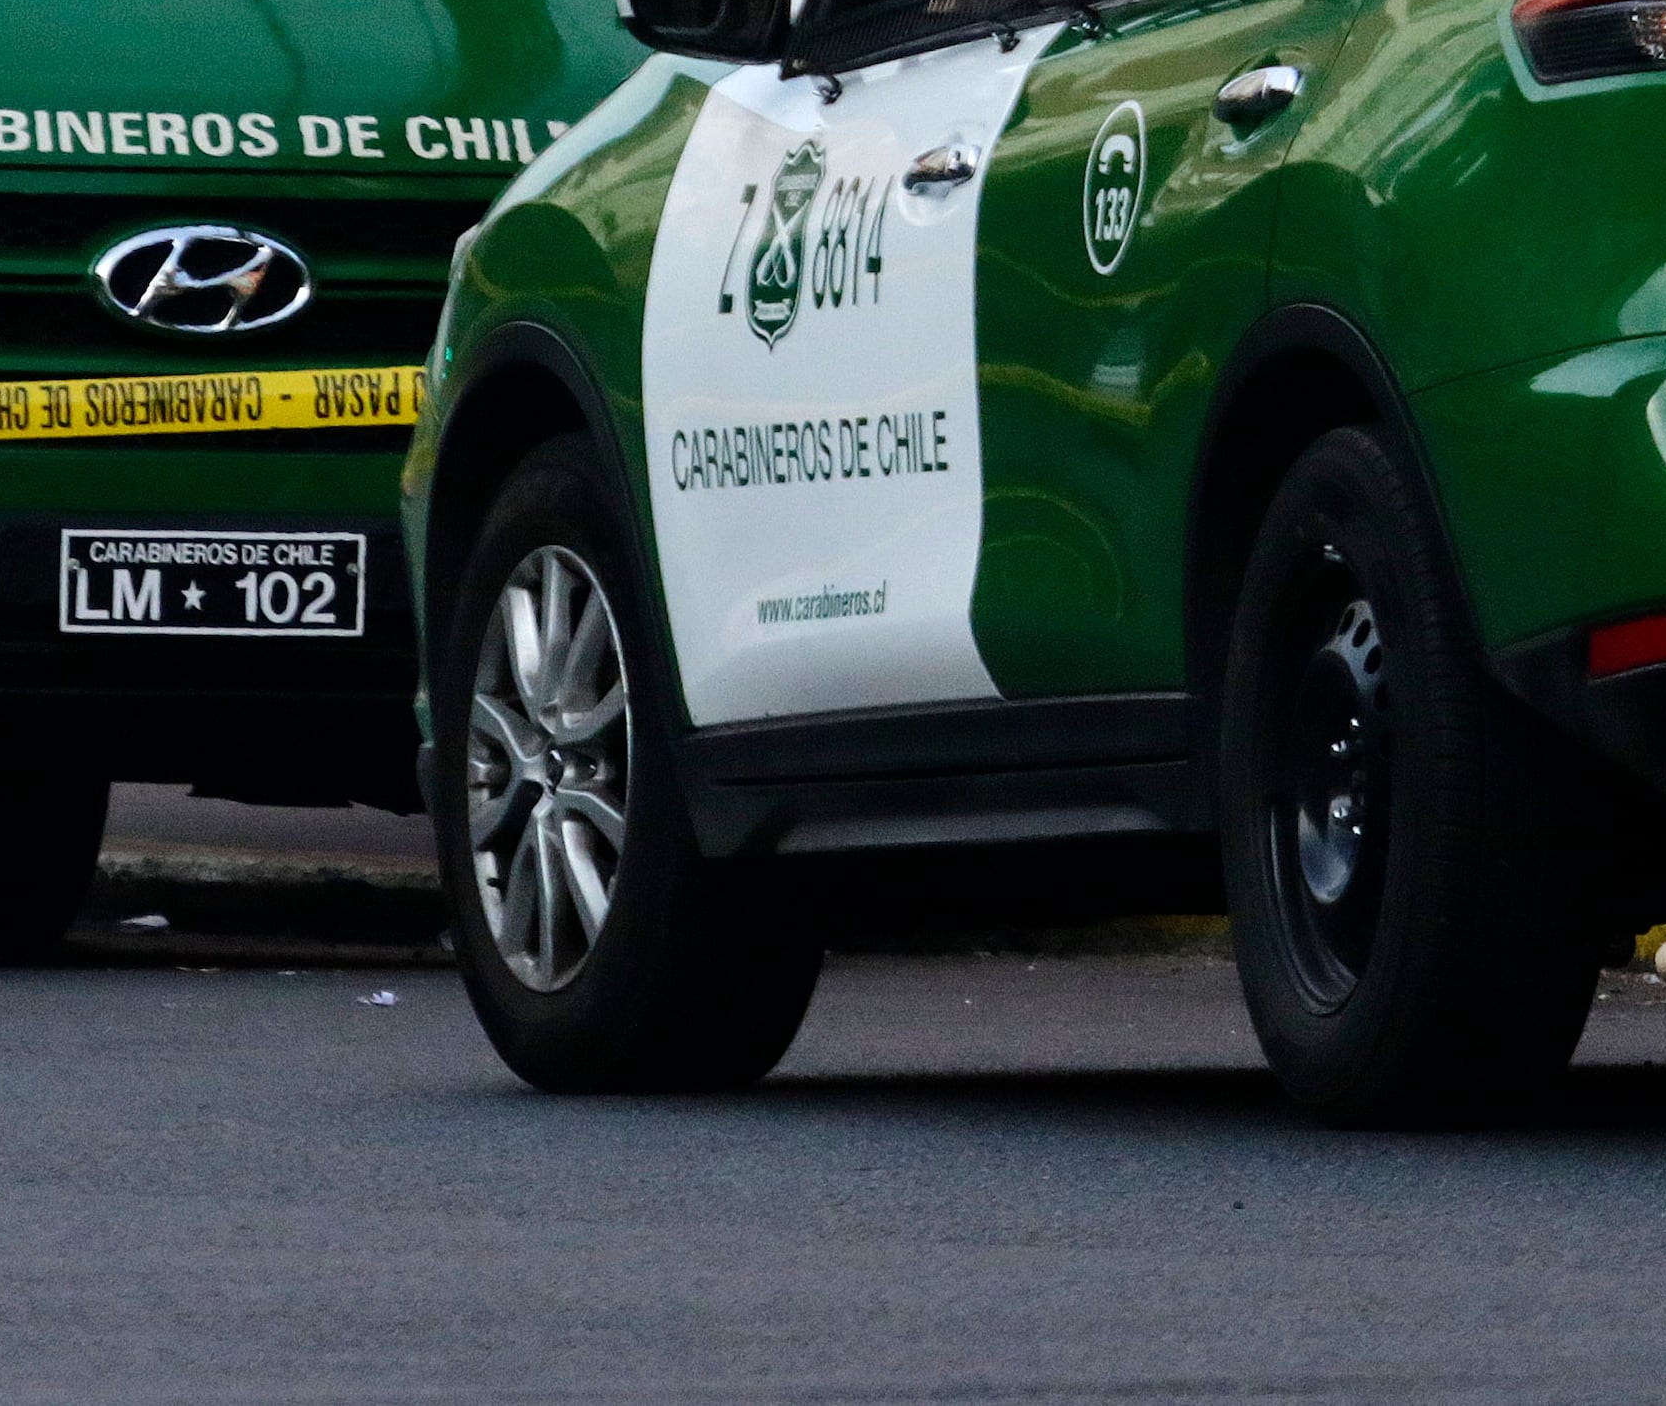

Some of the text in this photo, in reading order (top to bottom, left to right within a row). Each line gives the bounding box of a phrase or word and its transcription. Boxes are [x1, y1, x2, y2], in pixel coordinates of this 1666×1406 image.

[298, 115, 385, 158] DE
[1095, 187, 1131, 240] 133
[812, 173, 895, 310] 8814
[40, 385, 72, 429] DE
[85, 375, 263, 427] CARABINEROS
[313, 372, 401, 419] PASAR
[672, 411, 948, 491] CARABINEROS DE CHILE
[89, 541, 335, 566] CARABINEROS DE CHILE
[75, 568, 336, 624] LM 102
[756, 579, 886, 624] www.carabineros.cl
